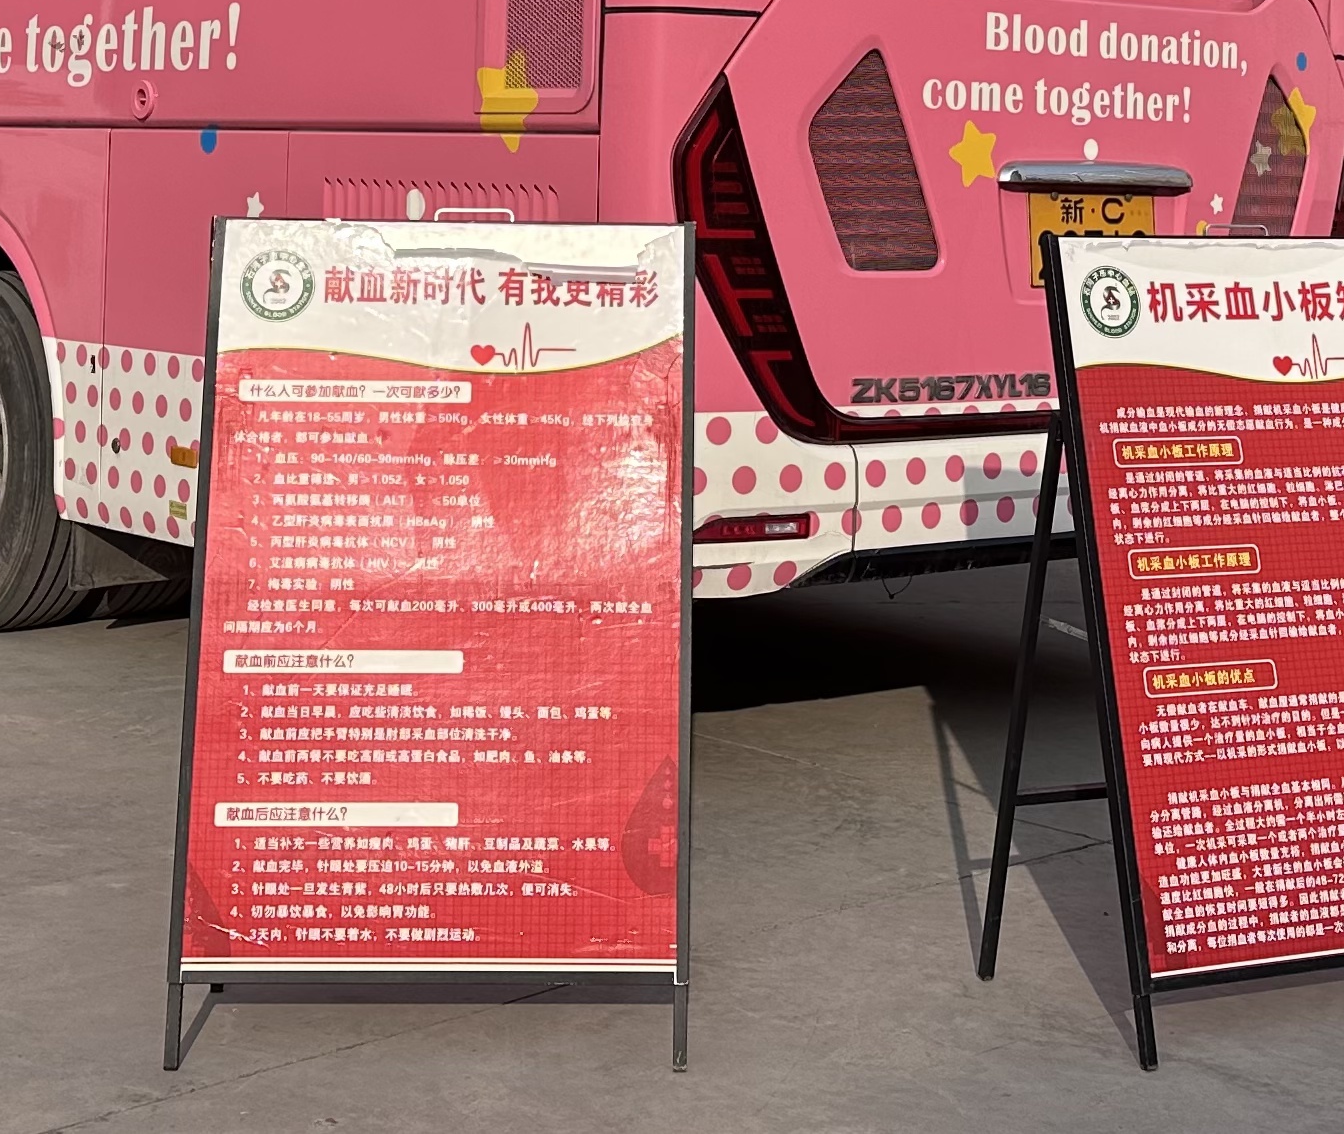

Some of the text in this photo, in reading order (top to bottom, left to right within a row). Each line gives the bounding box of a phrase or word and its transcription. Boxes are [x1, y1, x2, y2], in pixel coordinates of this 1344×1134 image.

[25, 2, 242, 88] together!
[985, 11, 1248, 77] Blood donation,
[922, 77, 1192, 126] come together!
[324, 267, 660, 309] 献血新时代 有我更精彩
[850, 373, 1051, 403] ZK5167XYL16
[1121, 443, 1235, 459] 机采血小板工作原理
[1136, 552, 1252, 572] 机采血小板工作原理
[235, 654, 355, 668] 献血前应注意什么？
[1152, 668, 1256, 690] 机采血小板的优点
[226, 806, 348, 822] 献血后应注意什么？
